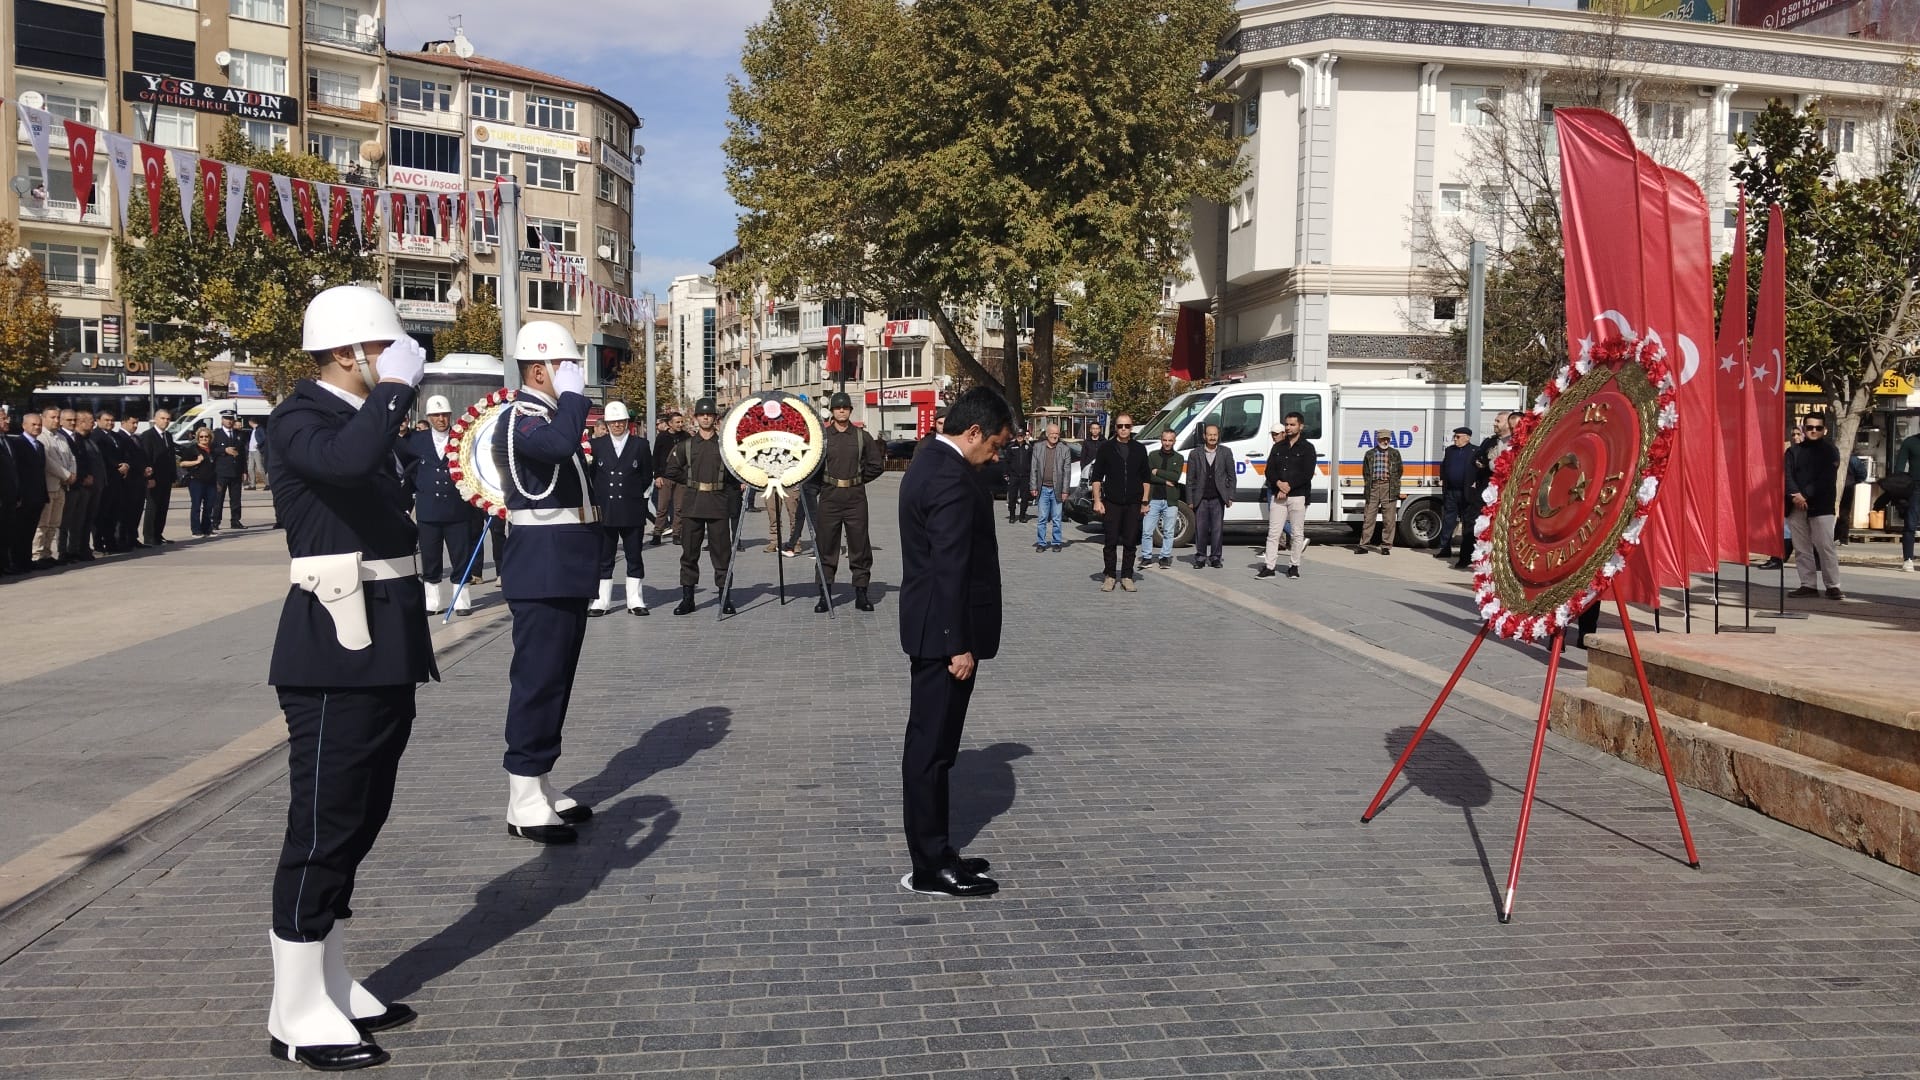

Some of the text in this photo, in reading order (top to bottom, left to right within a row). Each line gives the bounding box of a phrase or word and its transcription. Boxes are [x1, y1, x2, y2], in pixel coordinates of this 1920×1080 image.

[1787, 12, 1800, 24] 501
[1801, 8, 1810, 18] 10
[139, 90, 283, 120] GAYRİMENKUL İNŞAAT
[142, 75, 282, 110] YGS & AYDIN
